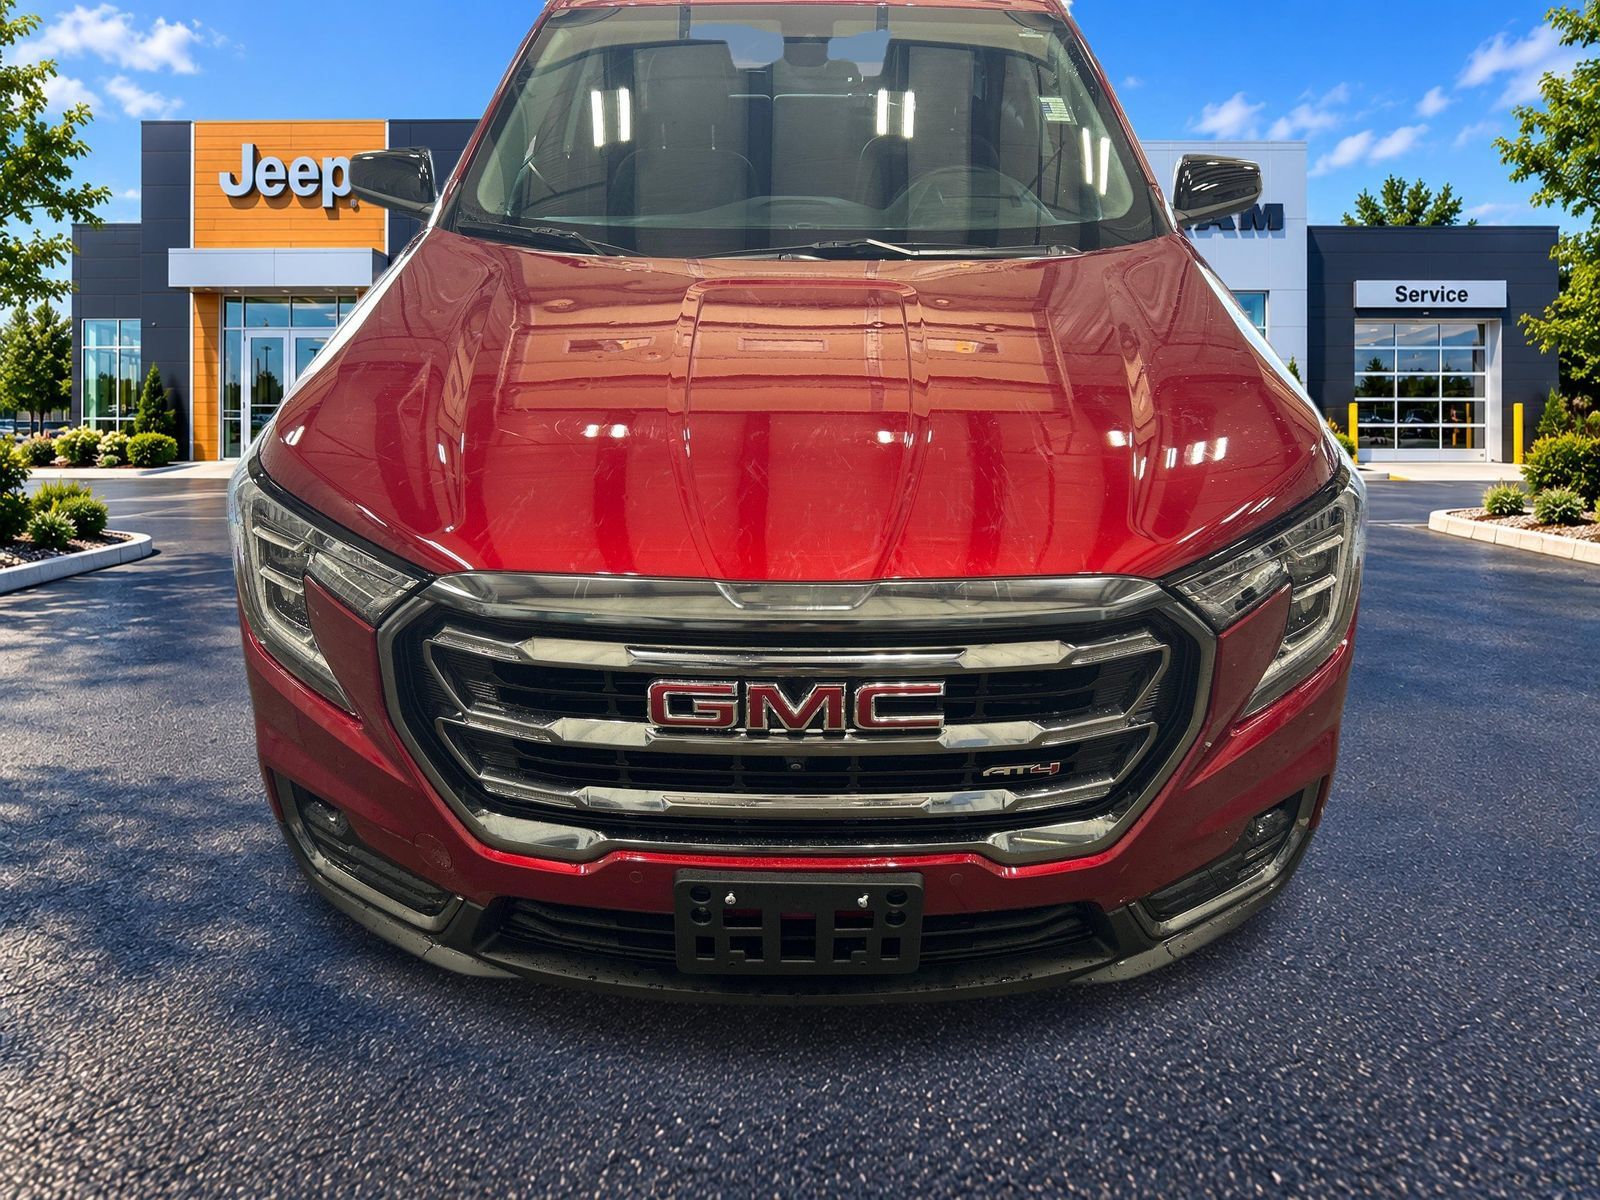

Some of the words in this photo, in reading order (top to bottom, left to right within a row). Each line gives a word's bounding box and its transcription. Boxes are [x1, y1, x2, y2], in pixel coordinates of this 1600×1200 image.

[218, 143, 352, 208] Jeep
[1395, 285, 1469, 303] Service
[647, 679, 946, 732] GMC
[982, 761, 1061, 777] AT4
